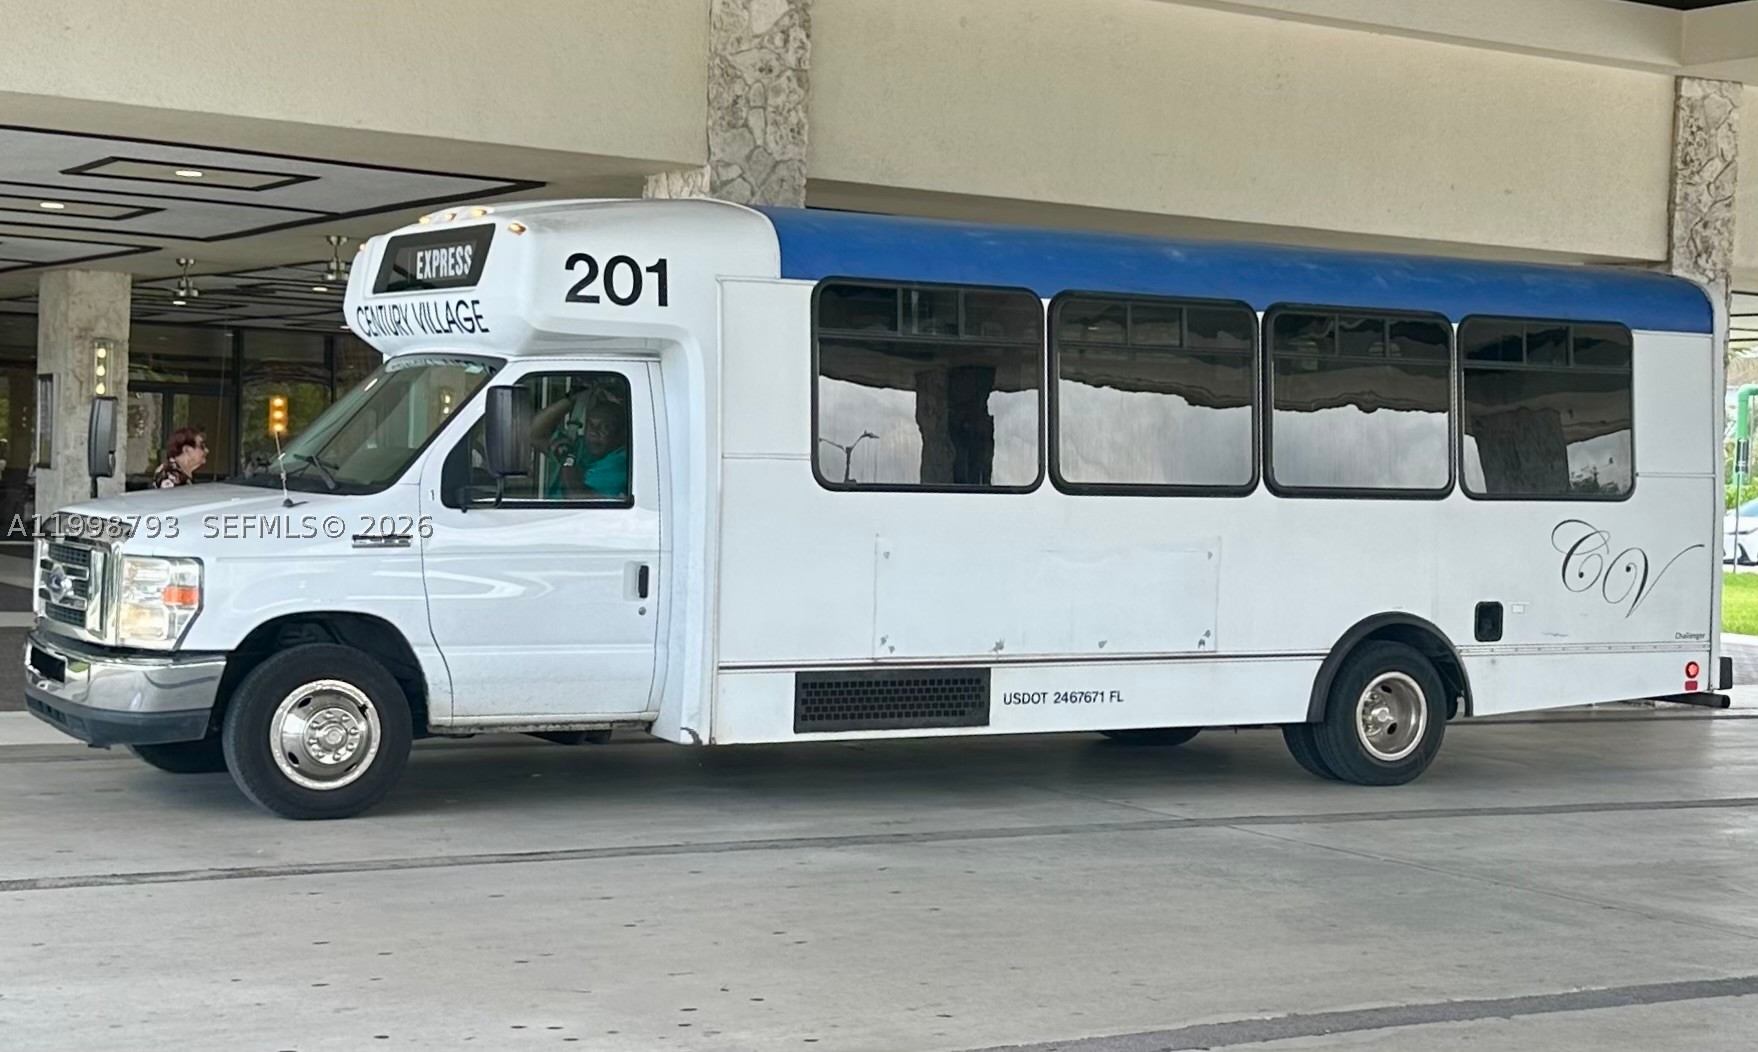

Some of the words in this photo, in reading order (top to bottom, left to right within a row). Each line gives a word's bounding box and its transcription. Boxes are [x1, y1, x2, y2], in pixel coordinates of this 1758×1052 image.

[415, 244, 473, 281] EXPRESS
[564, 252, 669, 307] 201
[356, 303, 414, 338] CENTURY
[411, 299, 490, 335] VILLAGE
[1003, 692, 1048, 705] USDOT
[1053, 691, 1105, 704] 2467671
[1109, 690, 1124, 703] FL
